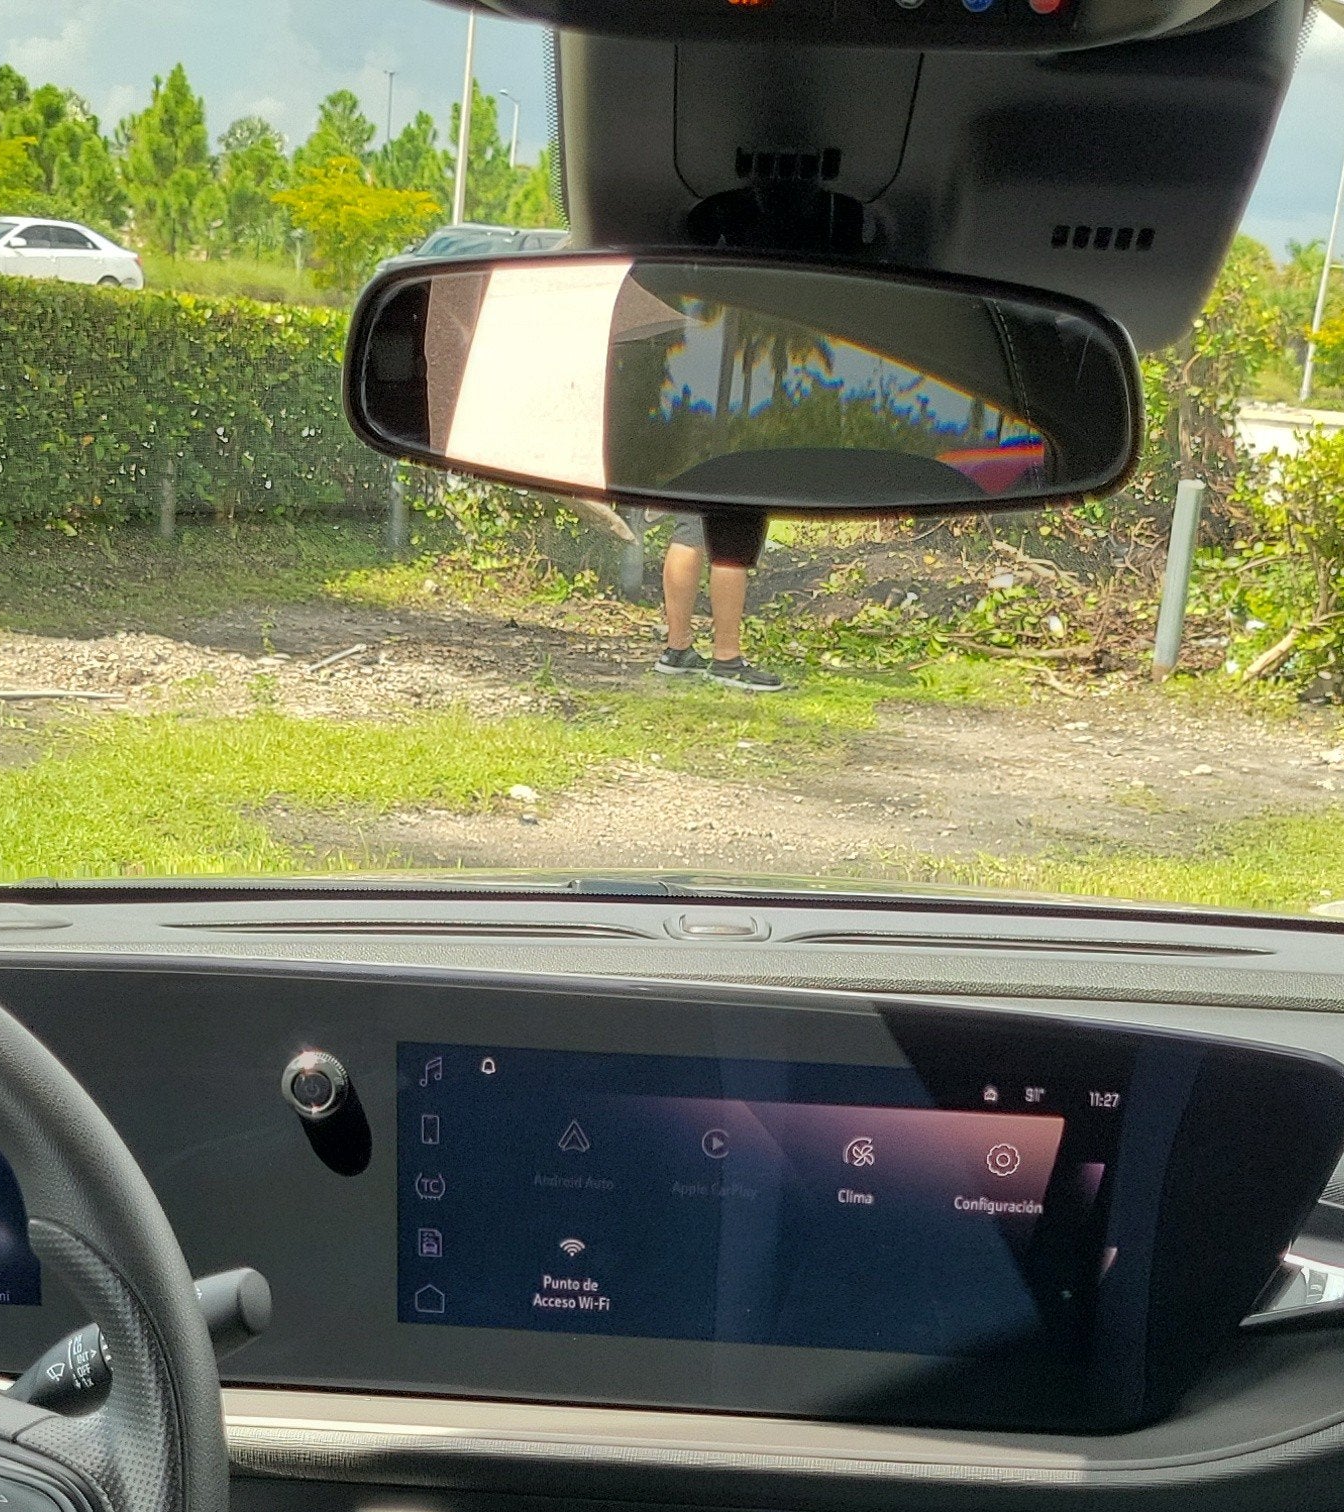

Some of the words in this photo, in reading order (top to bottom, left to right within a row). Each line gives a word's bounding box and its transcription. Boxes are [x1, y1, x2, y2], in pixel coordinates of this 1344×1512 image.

[1088, 1090, 1120, 1108] 11:27
[837, 1188, 874, 1205] Clima
[954, 1196, 1044, 1215] Configuración
[543, 1275, 580, 1292] Punto
[583, 1278, 598, 1292] de
[533, 1293, 576, 1309] Acceso
[578, 1296, 610, 1311] Wi-Fi
